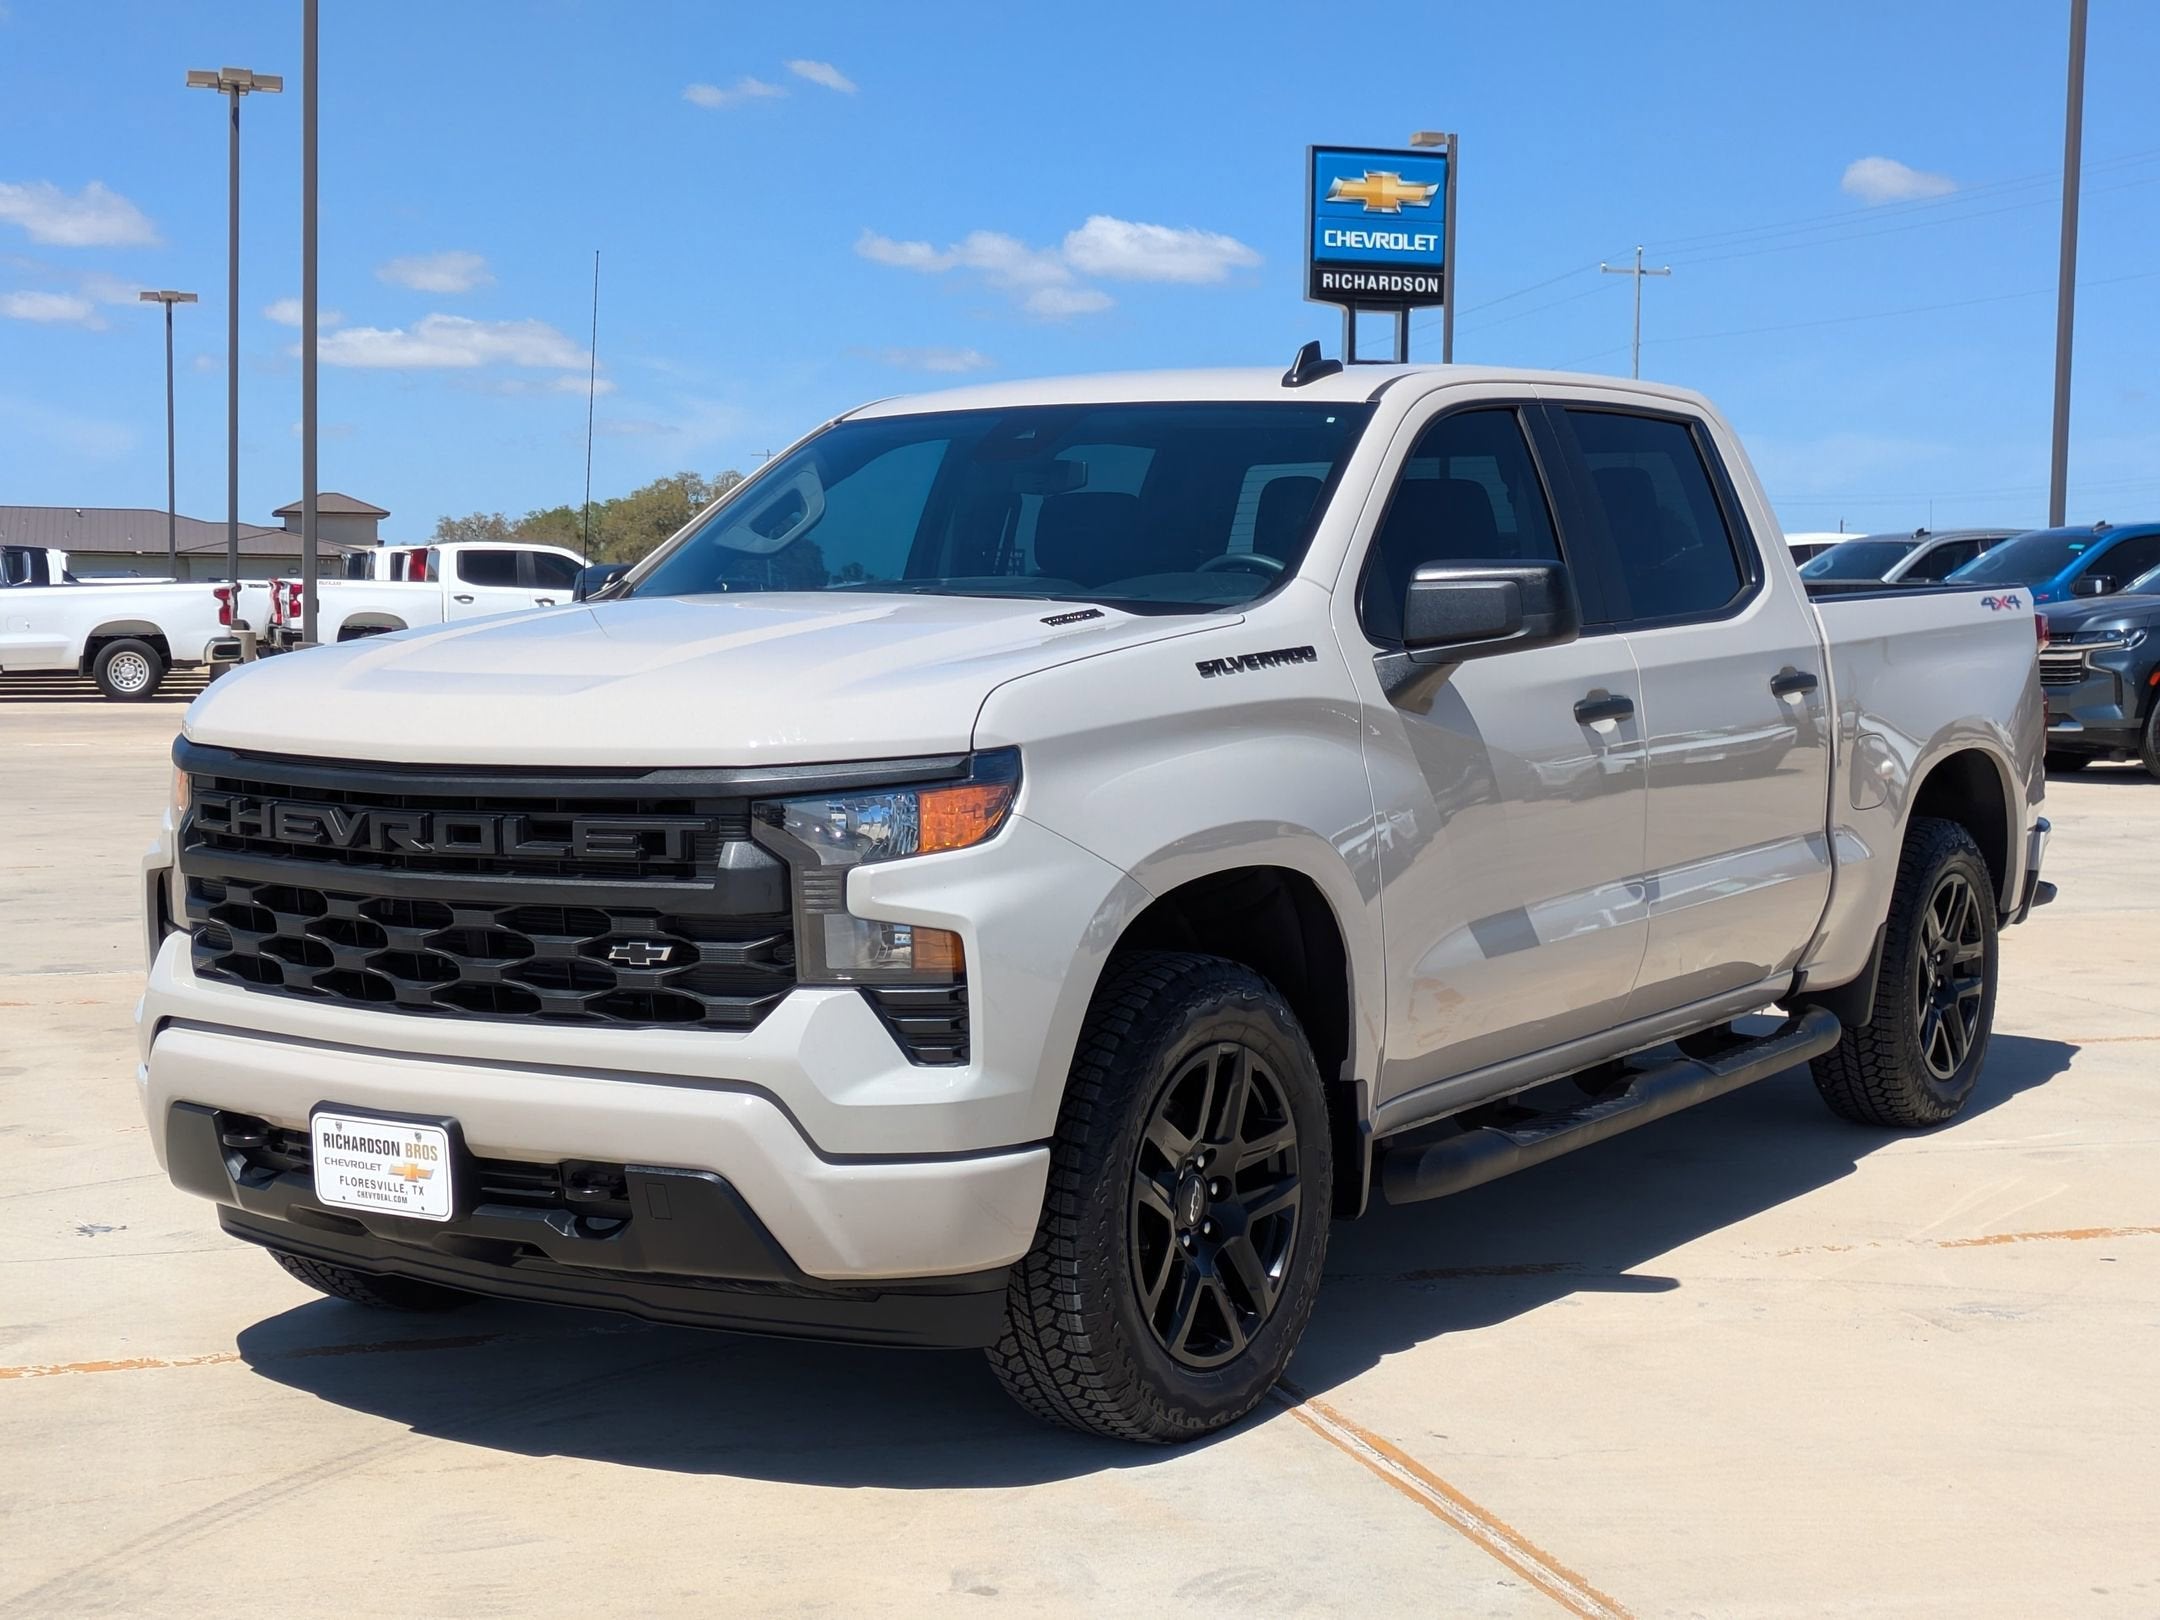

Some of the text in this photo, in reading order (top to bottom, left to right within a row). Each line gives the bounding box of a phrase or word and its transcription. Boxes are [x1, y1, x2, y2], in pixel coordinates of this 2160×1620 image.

[1324, 230, 1438, 252] CHEVROLET
[1322, 273, 1438, 293] RICHARDSON
[193, 792, 715, 860] CHEVROLET
[323, 1132, 438, 1161] RICHARDSON BROS
[324, 1156, 383, 1172] CHEVROLET
[339, 1175, 425, 1196] FLORESVILLE, TX
[357, 1190, 408, 1204] CHEVYDEAL.COM
